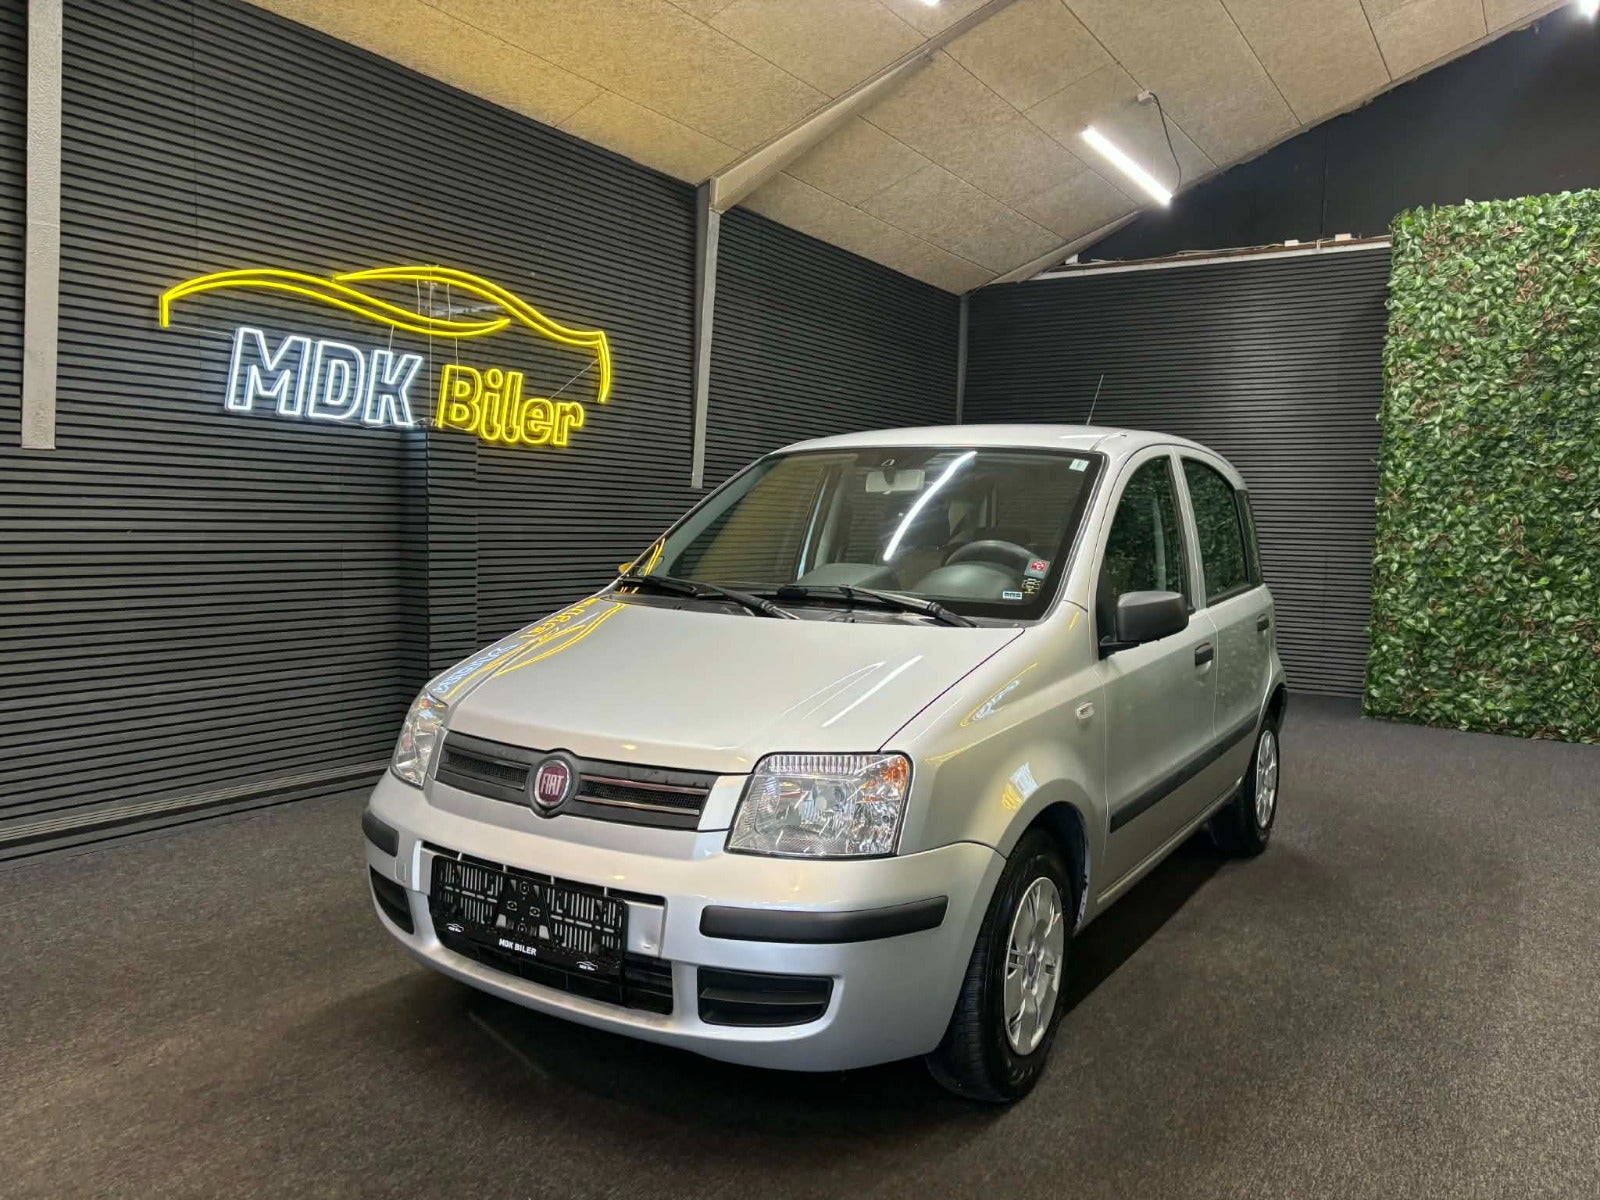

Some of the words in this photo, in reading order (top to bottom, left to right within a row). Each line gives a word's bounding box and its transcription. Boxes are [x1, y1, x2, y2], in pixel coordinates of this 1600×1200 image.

[225, 326, 423, 428] MDK
[436, 364, 585, 446] Biler
[540, 772, 565, 796] FIAT
[498, 938, 513, 950] MDK
[514, 942, 537, 956] BILER
